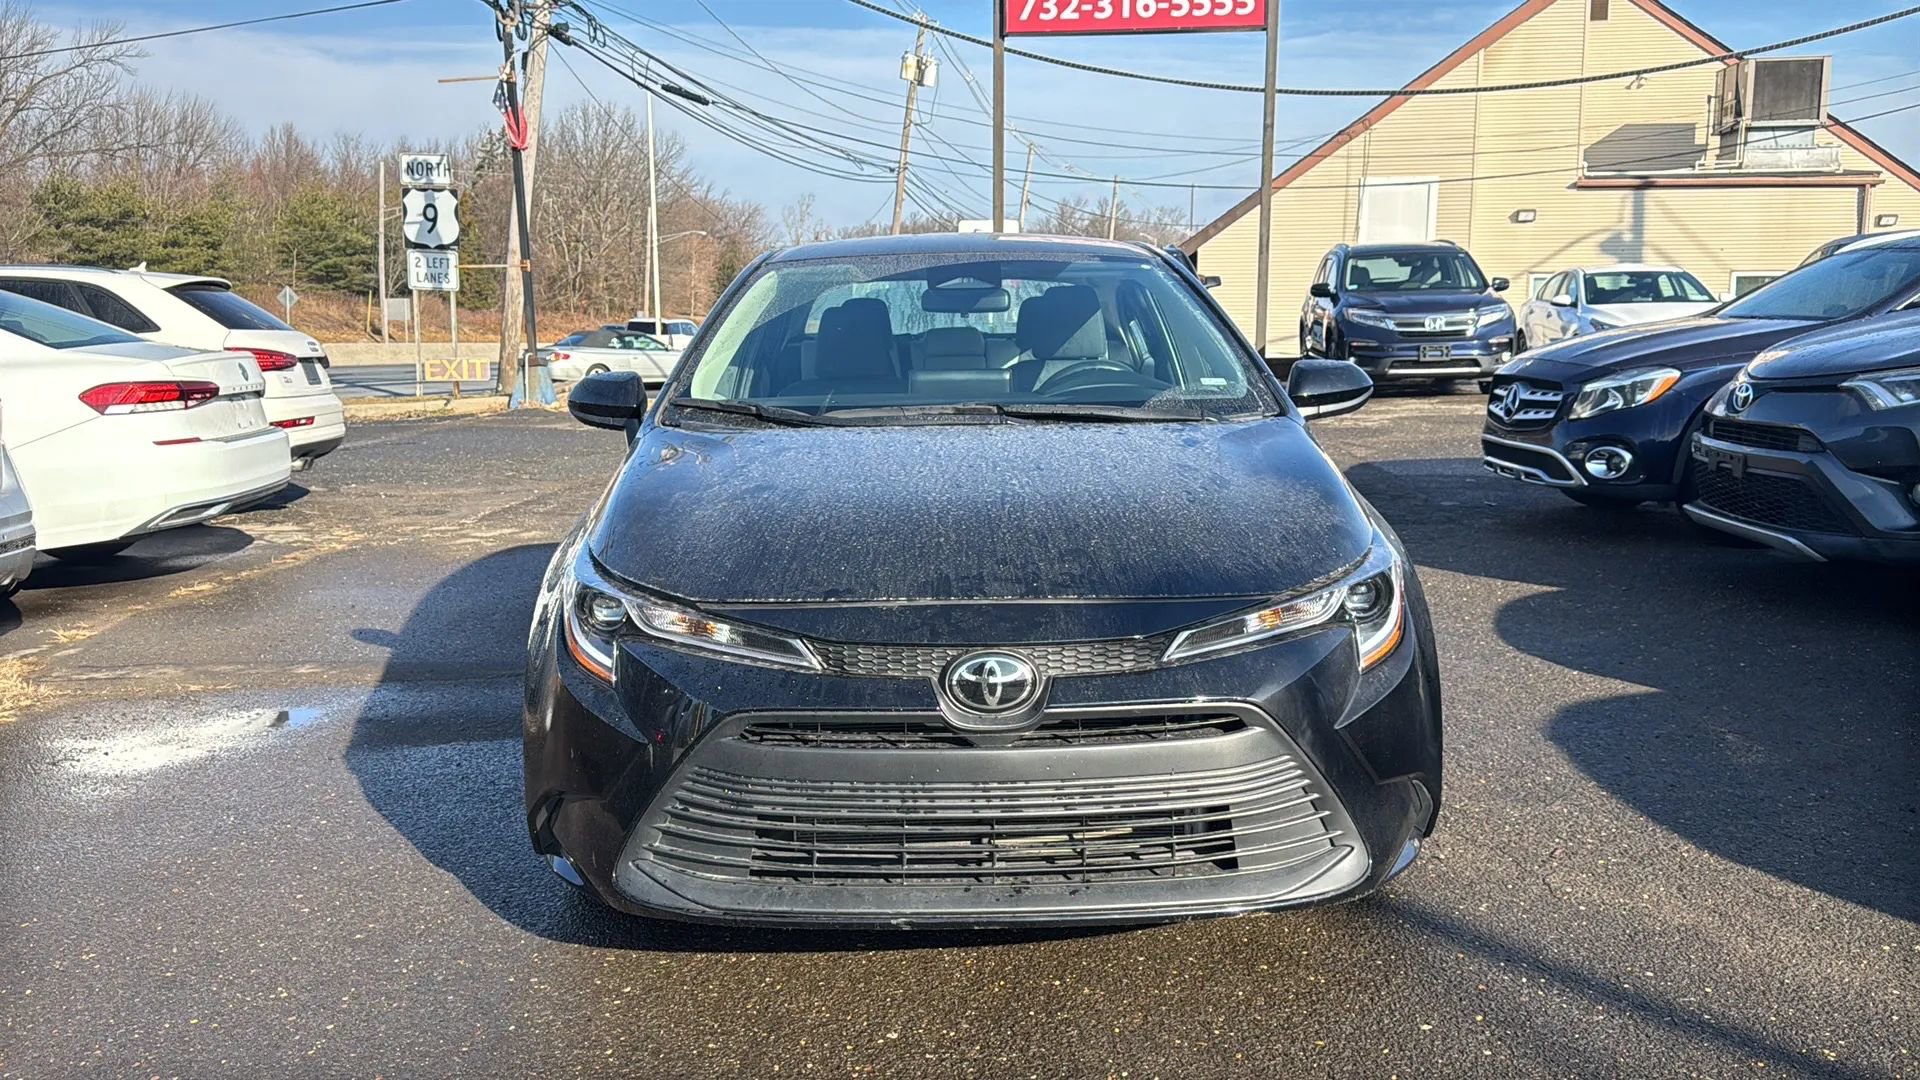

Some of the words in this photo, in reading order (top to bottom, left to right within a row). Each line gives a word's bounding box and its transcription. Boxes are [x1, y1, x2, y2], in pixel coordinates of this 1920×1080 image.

[406, 161, 452, 177] NORTH
[423, 203, 439, 235] 9
[415, 257, 422, 269] 2
[426, 258, 450, 270] LEFT
[416, 272, 450, 285] LANES
[425, 359, 489, 380] EXIT
